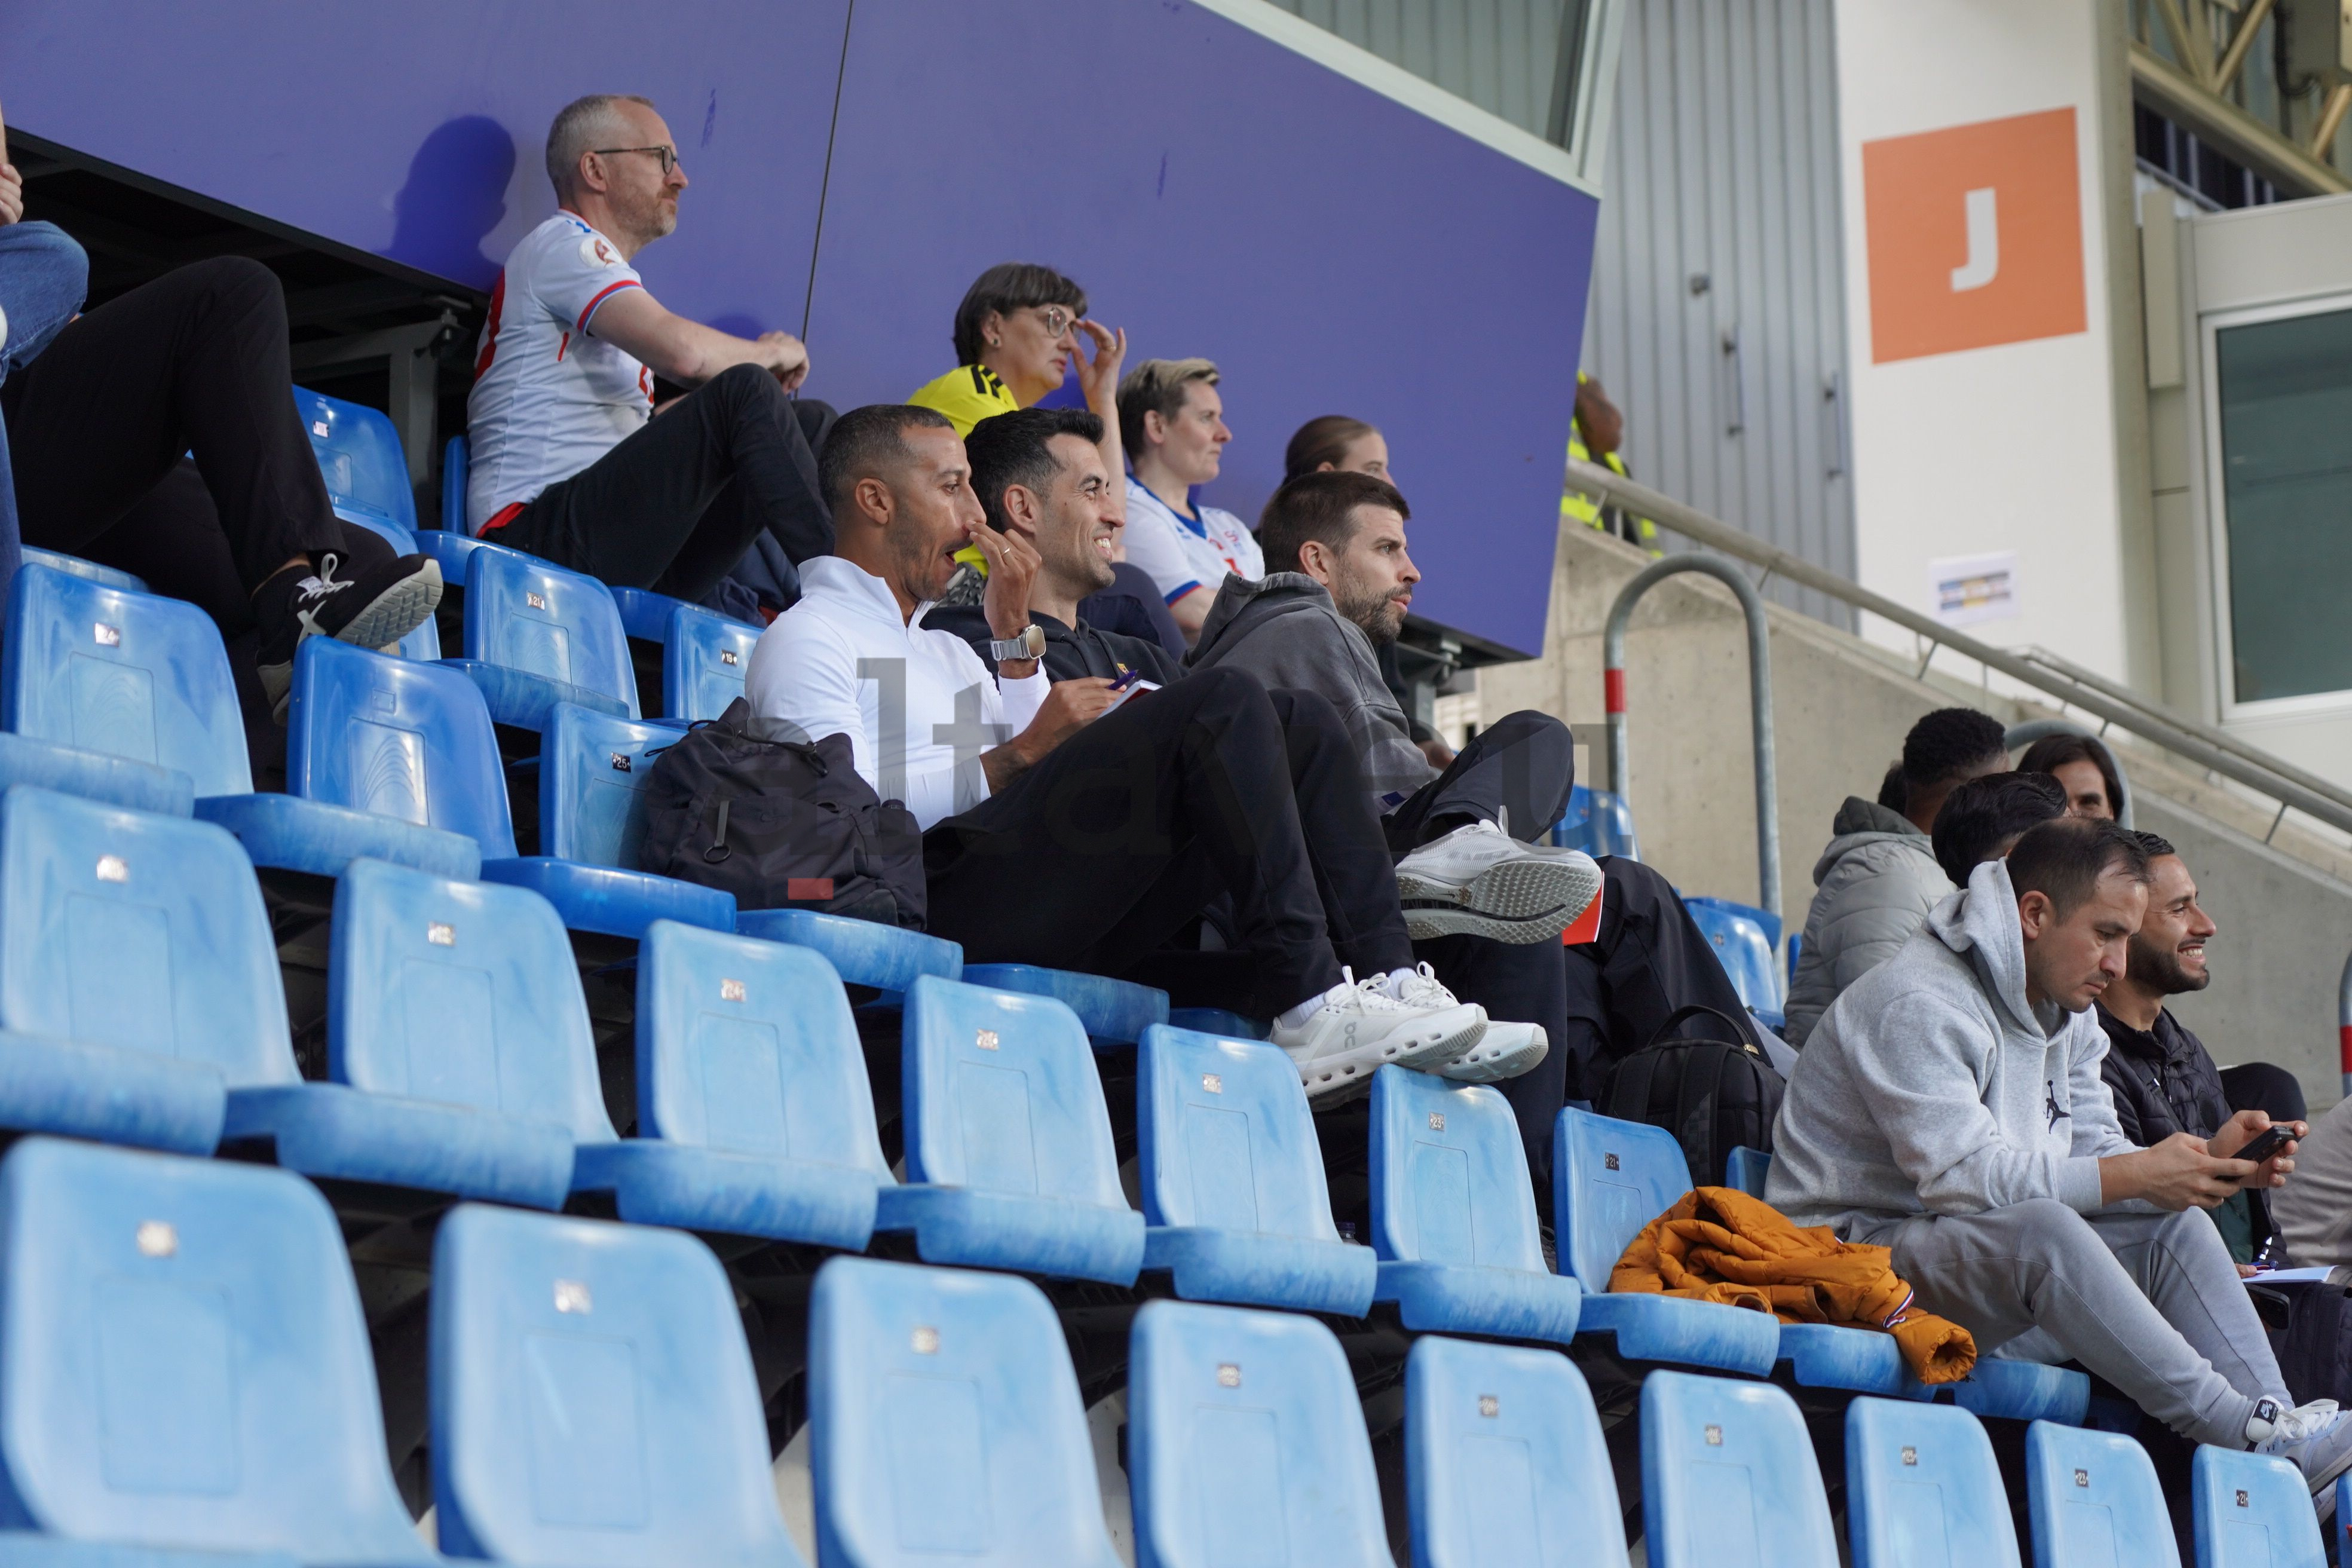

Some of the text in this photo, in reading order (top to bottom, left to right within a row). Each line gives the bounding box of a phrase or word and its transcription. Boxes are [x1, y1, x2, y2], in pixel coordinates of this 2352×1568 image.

[1950, 186, 1999, 292] J
[532, 597, 541, 606] 21
[725, 653, 733, 663] 19
[617, 758, 627, 769] 25
[1432, 1117, 1441, 1128] 23
[1609, 1157, 1616, 1168] 21
[2078, 1473, 2087, 1485] 23
[2240, 1493, 2246, 1504] 21
